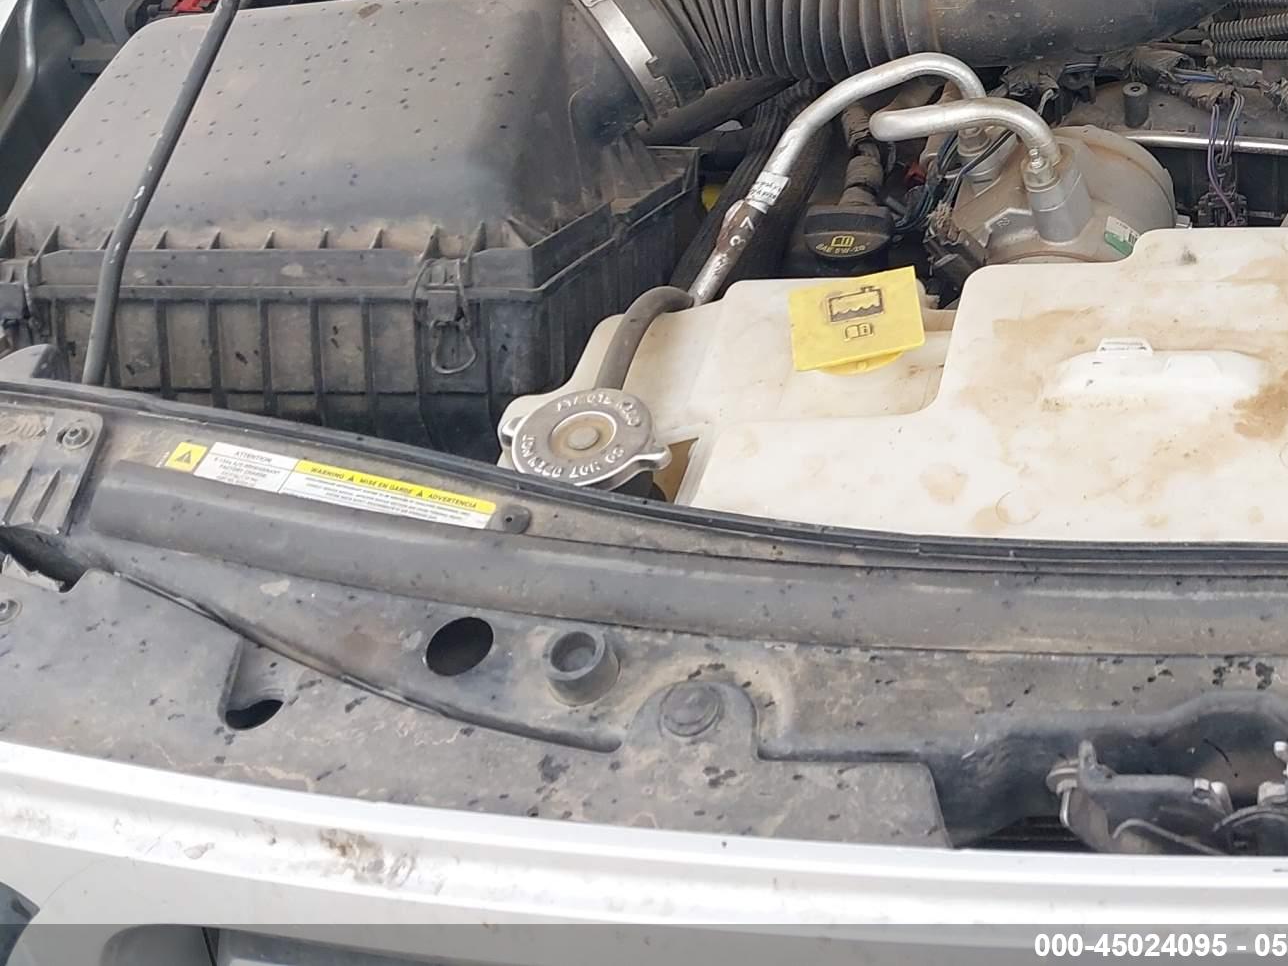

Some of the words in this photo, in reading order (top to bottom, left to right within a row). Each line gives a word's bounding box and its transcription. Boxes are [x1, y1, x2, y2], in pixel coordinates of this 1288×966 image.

[311, 466, 345, 480] WARNING
[359, 478, 377, 487] MISE
[377, 481, 389, 490] EN
[427, 493, 478, 509] ADVERTENCIA
